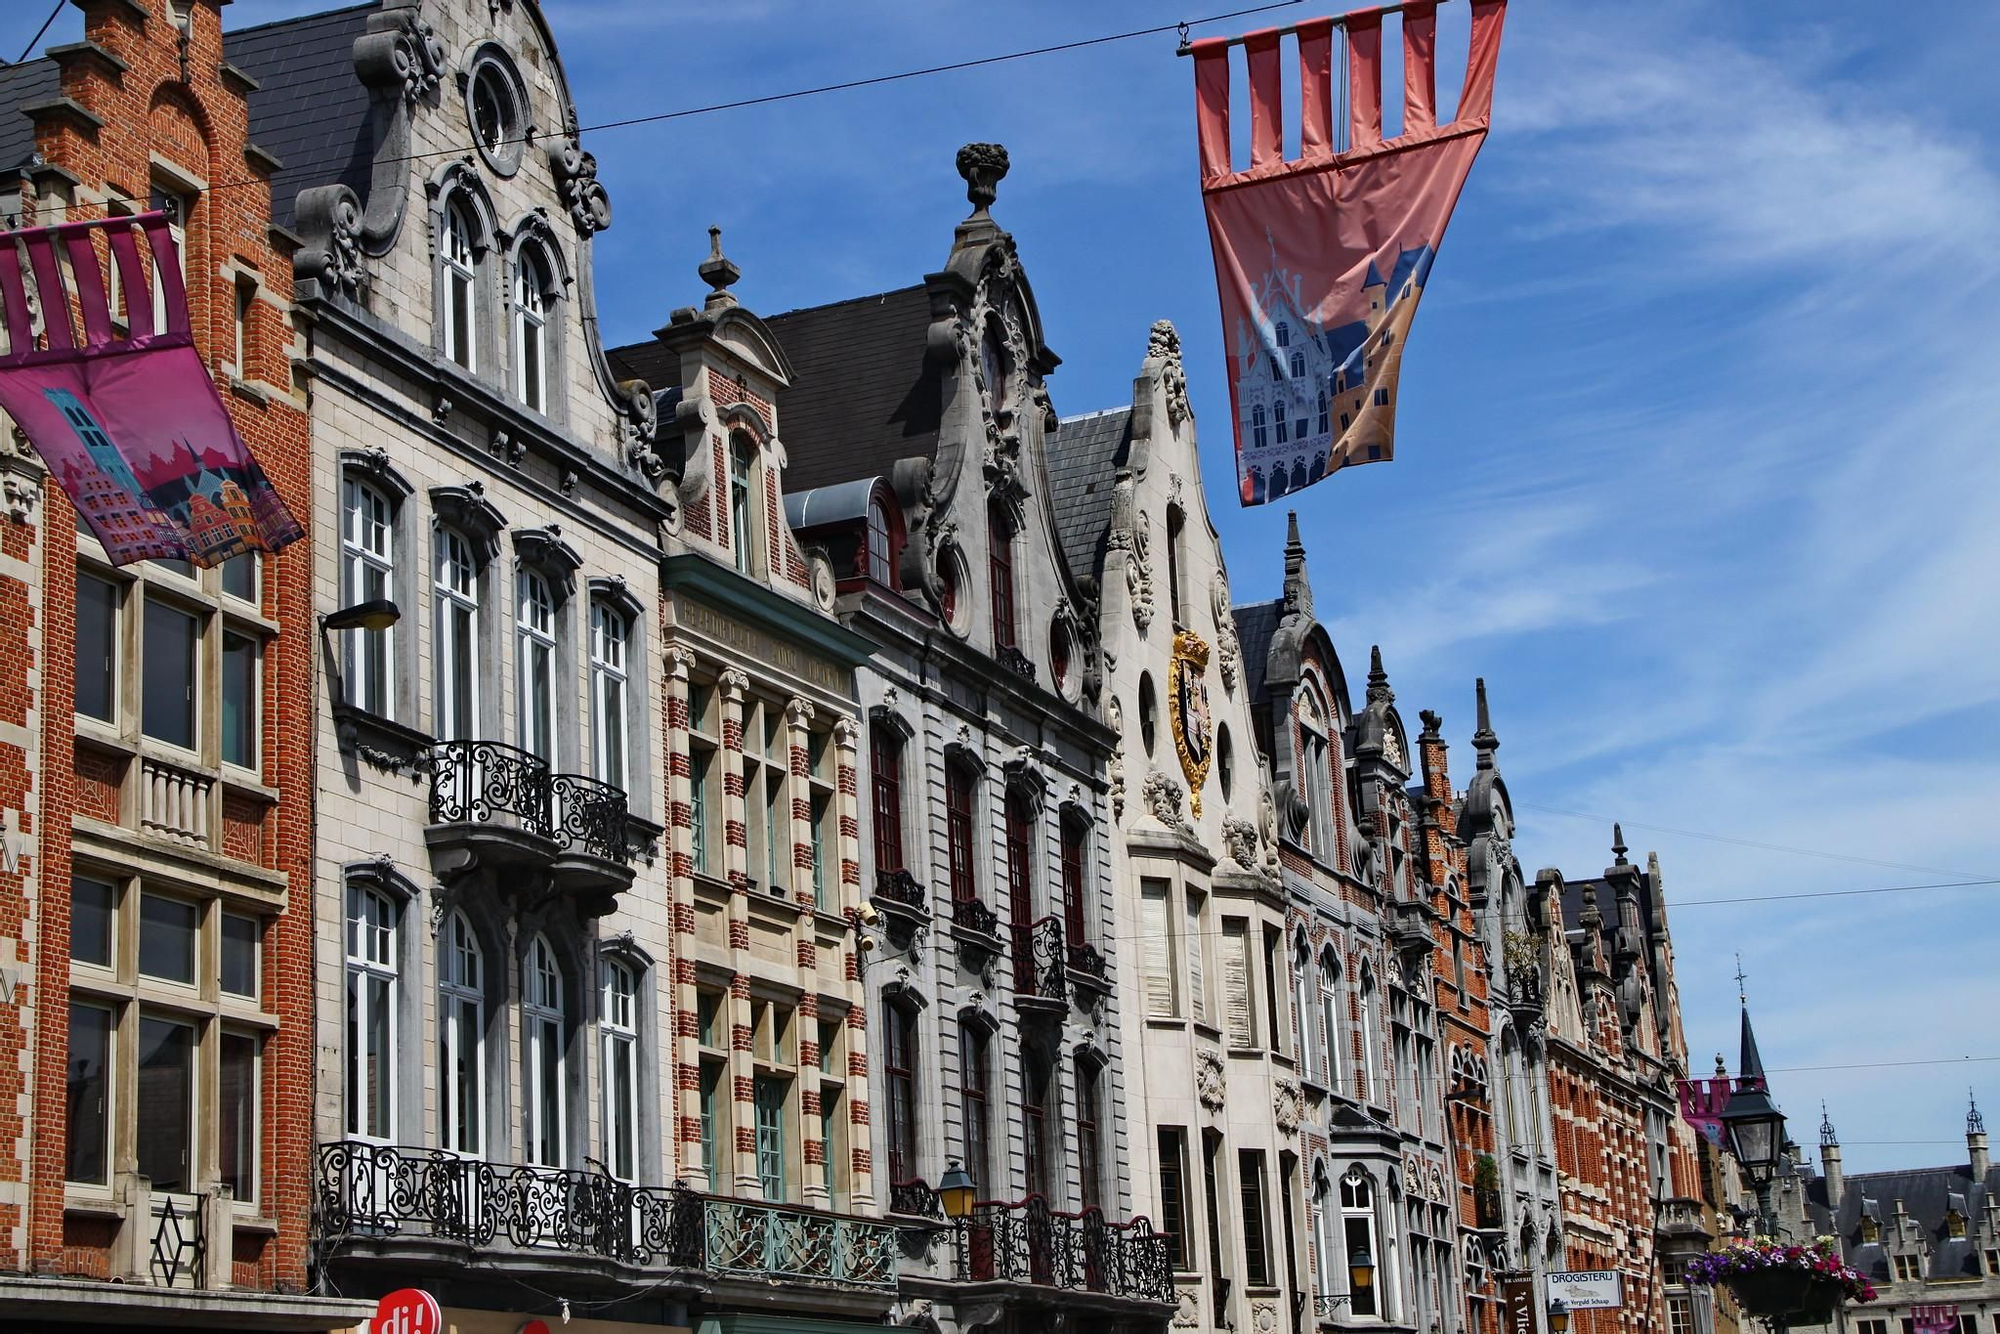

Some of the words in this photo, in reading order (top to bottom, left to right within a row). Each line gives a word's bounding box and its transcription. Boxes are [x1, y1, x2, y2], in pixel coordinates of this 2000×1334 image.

[1552, 1272, 1613, 1283] DROGISTERIJ
[1571, 1298, 1589, 1306] Verguld
[381, 1303, 423, 1334] di!
